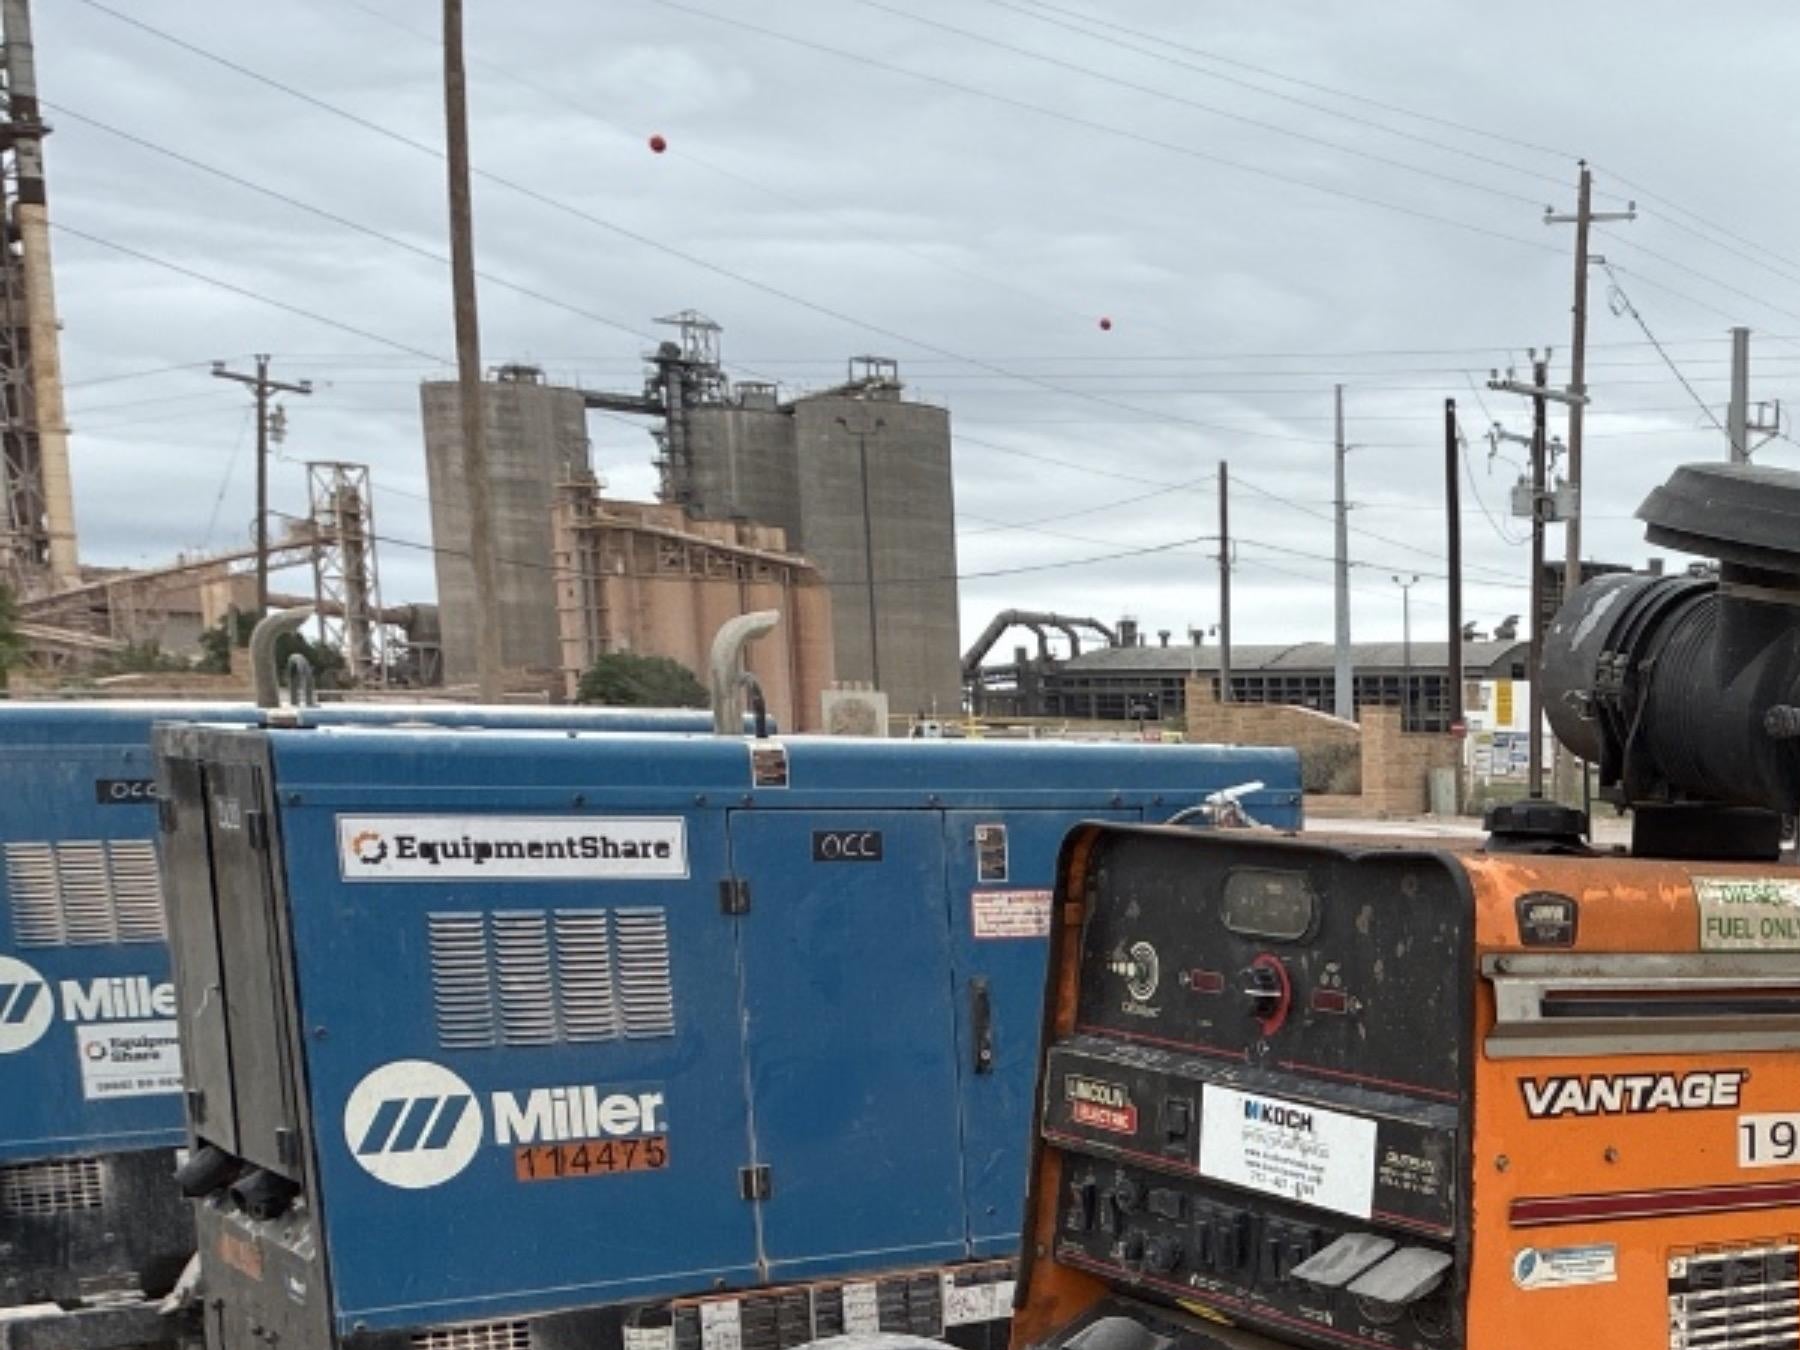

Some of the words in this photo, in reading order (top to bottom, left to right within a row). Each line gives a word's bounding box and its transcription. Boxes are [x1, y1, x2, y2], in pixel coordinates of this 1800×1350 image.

[394, 834, 671, 865] EquipmentShare
[821, 833, 876, 859] OCC
[1707, 917, 1755, 940] FUEL
[59, 975, 178, 1021] Mille
[1519, 1071, 1742, 1117] VANTAGE
[491, 1084, 665, 1146] Miller
[1261, 1103, 1312, 1133] KOCH
[520, 1136, 667, 1179] 114475
